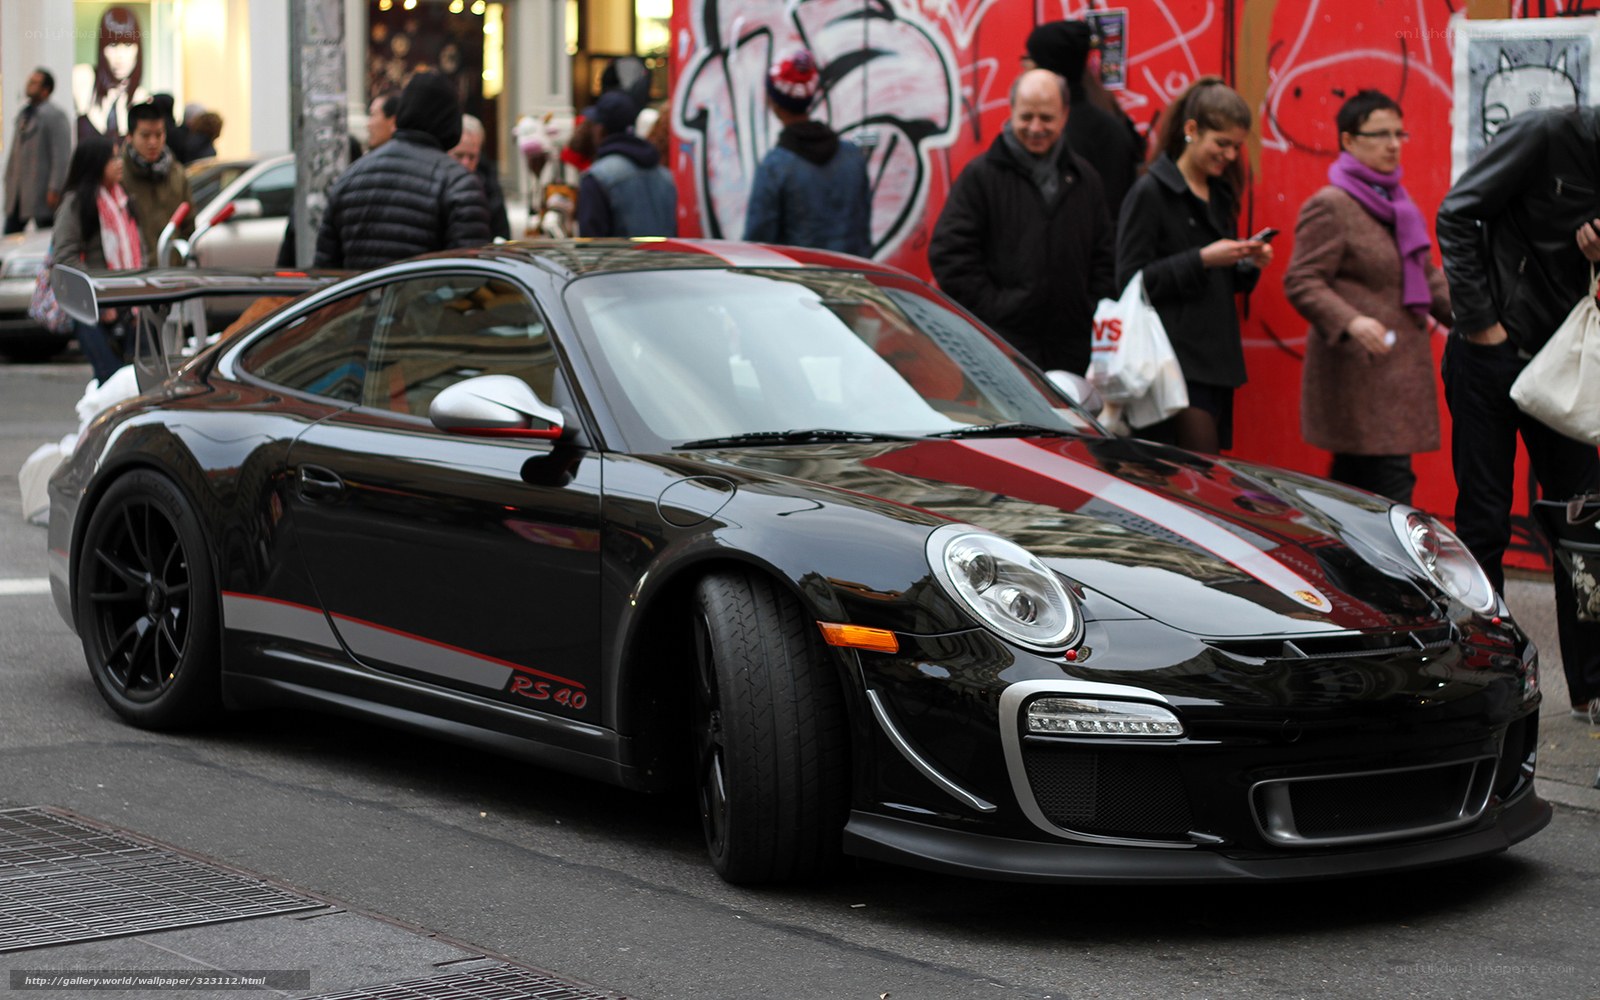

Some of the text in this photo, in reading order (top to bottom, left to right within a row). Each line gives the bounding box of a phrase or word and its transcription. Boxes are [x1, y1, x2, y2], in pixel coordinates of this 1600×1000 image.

[1092, 318, 1122, 342] VS
[510, 675, 587, 709] RS 4.0
